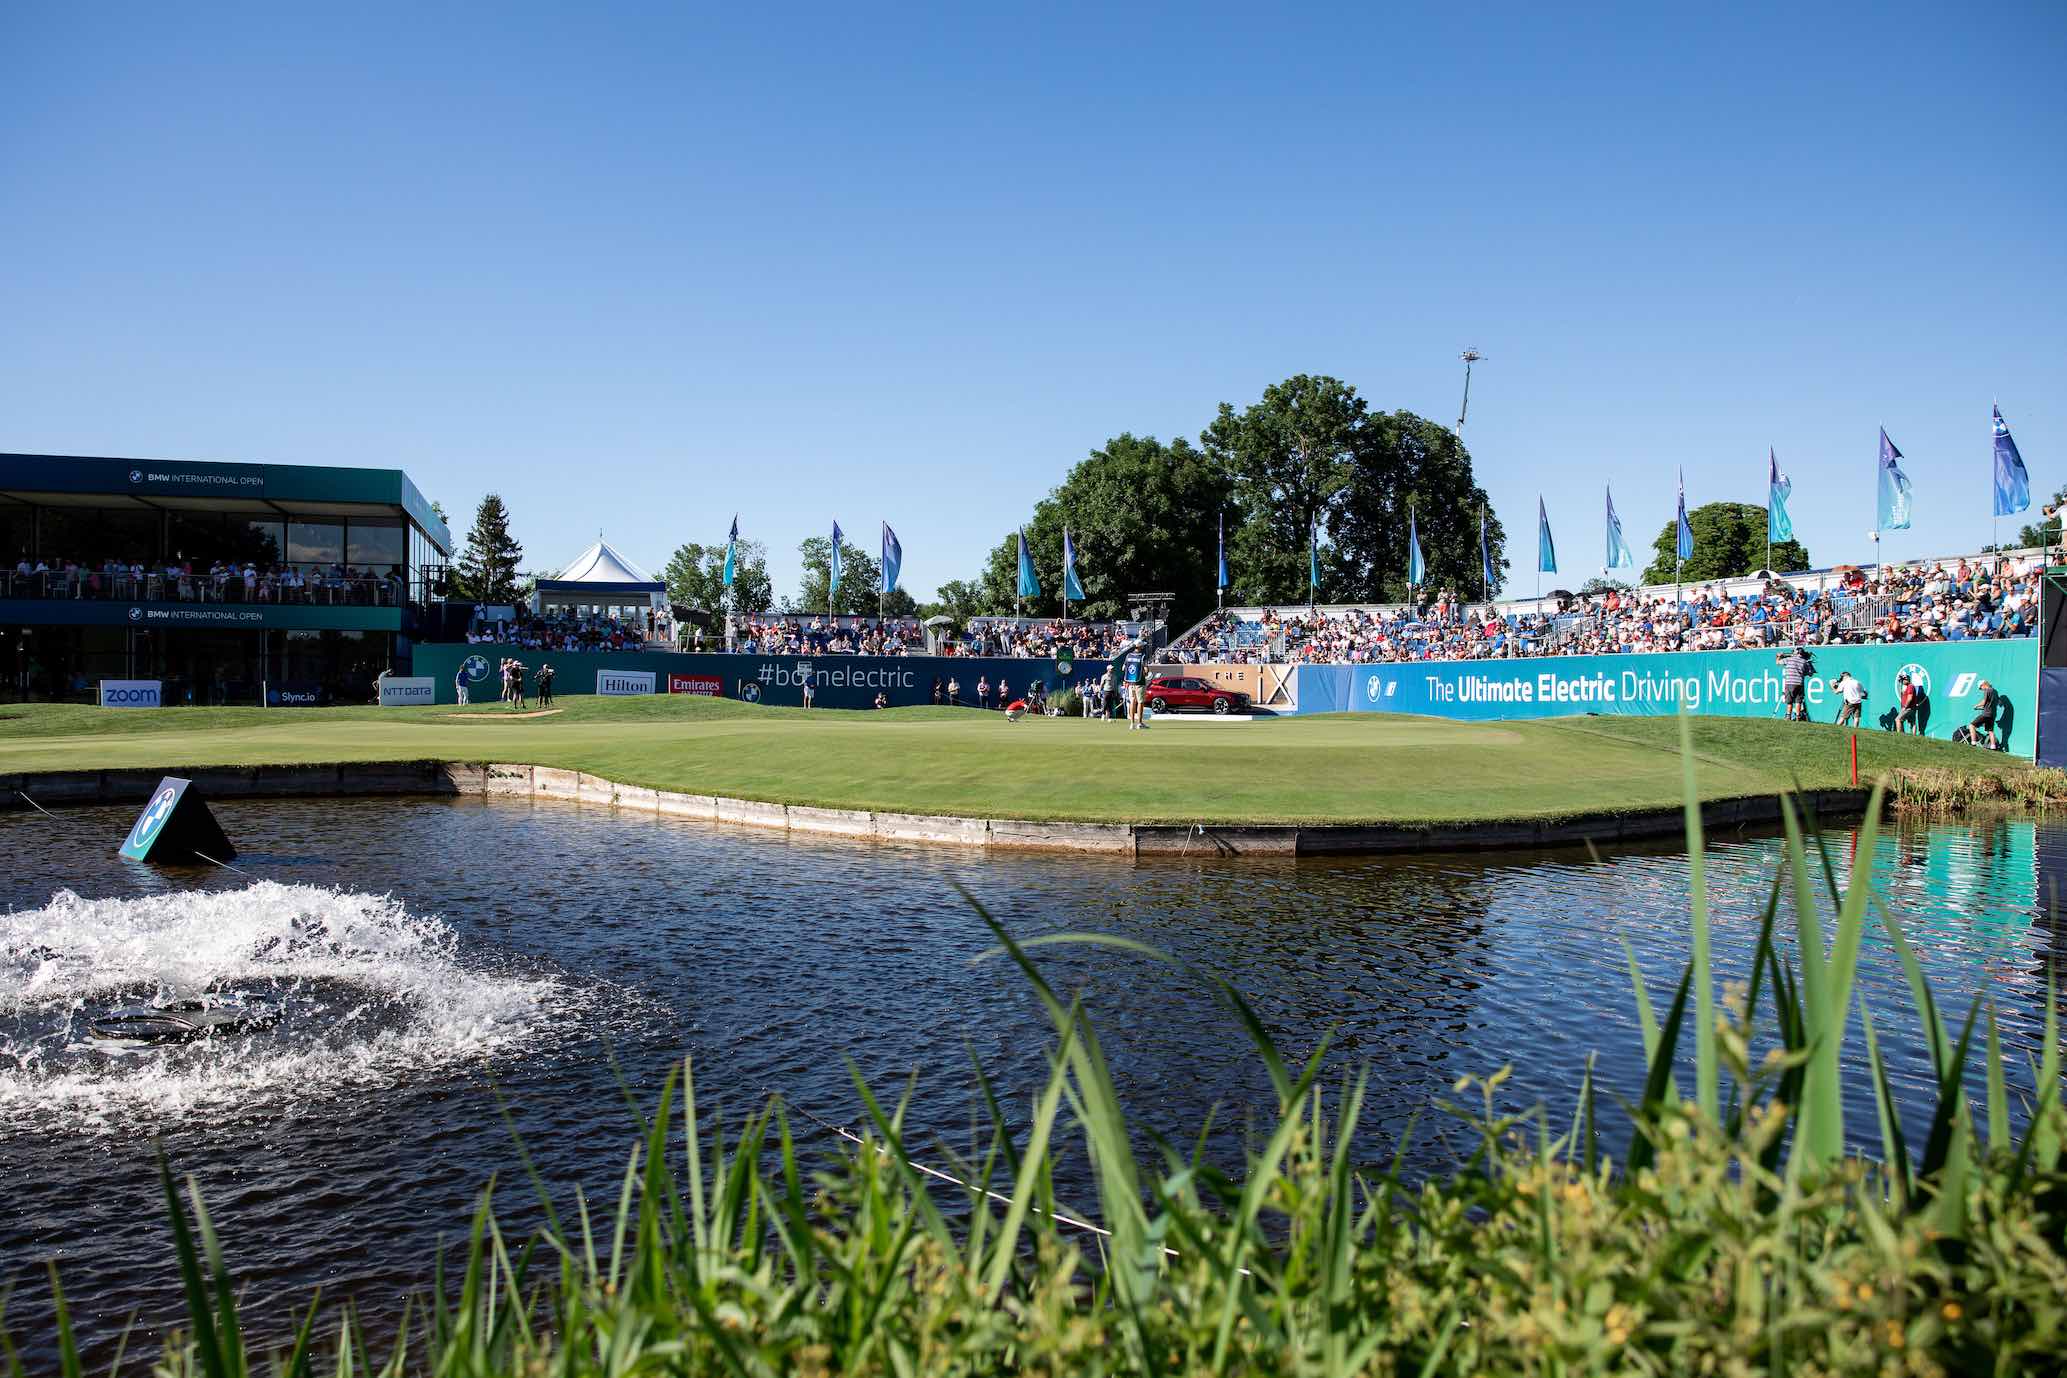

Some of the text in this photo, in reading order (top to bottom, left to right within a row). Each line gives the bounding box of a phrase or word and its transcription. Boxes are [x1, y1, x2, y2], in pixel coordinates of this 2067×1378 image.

[147, 473, 264, 486] BMW INTERNATIONAL OPEN
[147, 610, 263, 621] BMW INTERNATIONAL OPEN
[757, 663, 914, 688] #bonelectric
[605, 679, 648, 692] Hilton
[673, 679, 720, 691] Emirates
[1425, 668, 1824, 709] The Ultimate Electric Driving Machie
[105, 688, 158, 703] zoom
[281, 691, 316, 704] Slync.io
